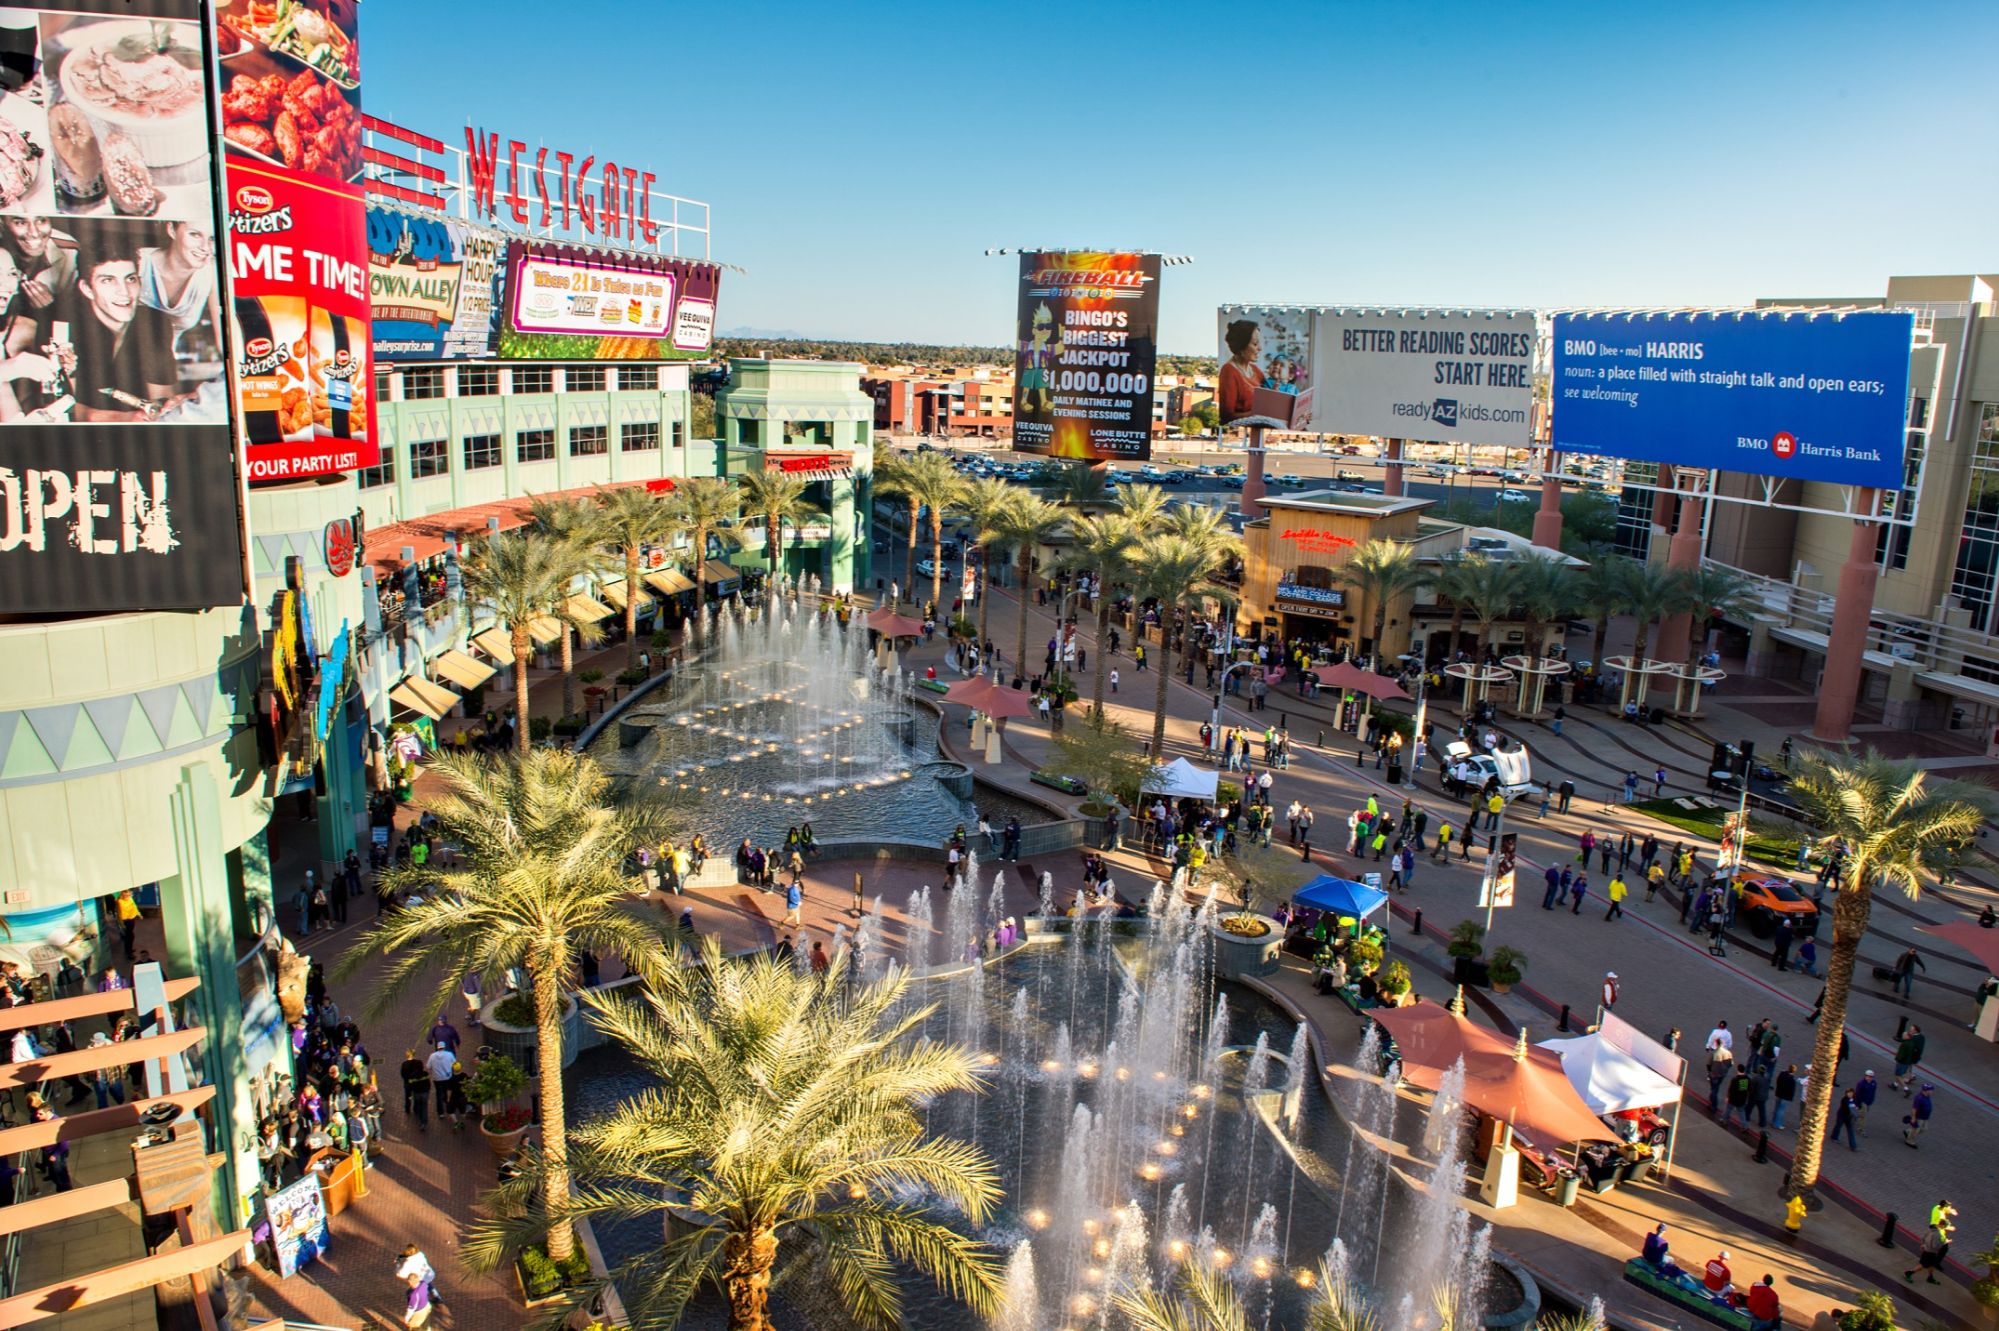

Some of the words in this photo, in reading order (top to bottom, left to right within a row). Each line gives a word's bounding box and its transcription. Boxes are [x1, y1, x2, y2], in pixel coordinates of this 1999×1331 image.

[464, 126, 657, 244] WESTGATE
[242, 191, 270, 206] Tyson
[465, 236, 498, 260] HAPPY
[303, 249, 365, 300] TIME!
[466, 260, 493, 283] HOUR
[1037, 269, 1145, 287] FIREBALL
[410, 278, 457, 308] ALLEY
[533, 270, 570, 290] Where
[572, 272, 588, 292] 21
[604, 278, 631, 294] Twice
[645, 282, 663, 297] Fun
[1065, 310, 1128, 327] BINGO'S
[679, 330, 706, 338] CASINO
[1063, 330, 1129, 347] BIGGEST
[1343, 328, 1395, 352] BETTER
[1400, 331, 1464, 355] READING
[1469, 332, 1530, 358] SCORES
[1059, 350, 1130, 367] JACKPOT
[1564, 340, 1596, 356] BMO
[1646, 342, 1704, 360] HARRIS
[1042, 369, 1147, 394] $1,000,000
[1434, 361, 1483, 386] START
[1488, 364, 1532, 388] HERE.
[1564, 367, 1595, 378] noun:
[1598, 367, 1605, 378] a
[1608, 365, 1636, 381] place
[1639, 366, 1667, 381] filled
[1670, 368, 1696, 383] with
[1699, 370, 1747, 389] straight
[1750, 373, 1775, 388] talk
[1779, 374, 1805, 389] and
[1808, 378, 1844, 393] open
[1849, 380, 1885, 396] ears;
[1053, 396, 1074, 407] DAILY
[1076, 397, 1113, 408] MATINEE
[1114, 399, 1132, 408] AND
[1564, 387, 1579, 398] see
[1582, 385, 1639, 408] welcoming
[1053, 408, 1087, 418] EVENING
[1089, 409, 1131, 420] SESSIONS
[1016, 421, 1030, 430] VEE
[1031, 422, 1054, 432] QUIVA
[1090, 429, 1115, 437] LONE
[1116, 430, 1146, 439] BUTTE
[1017, 436, 1050, 444] CASINO
[1094, 442, 1140, 450] CASINO
[1737, 437, 1768, 450] BMO
[1801, 443, 1842, 458] Harris
[1845, 447, 1881, 462] Bank
[246, 458, 289, 477] YOUR
[292, 455, 333, 473] PARTY
[335, 452, 358, 468] LIST!
[270, 1185, 317, 1215] WELCOME
